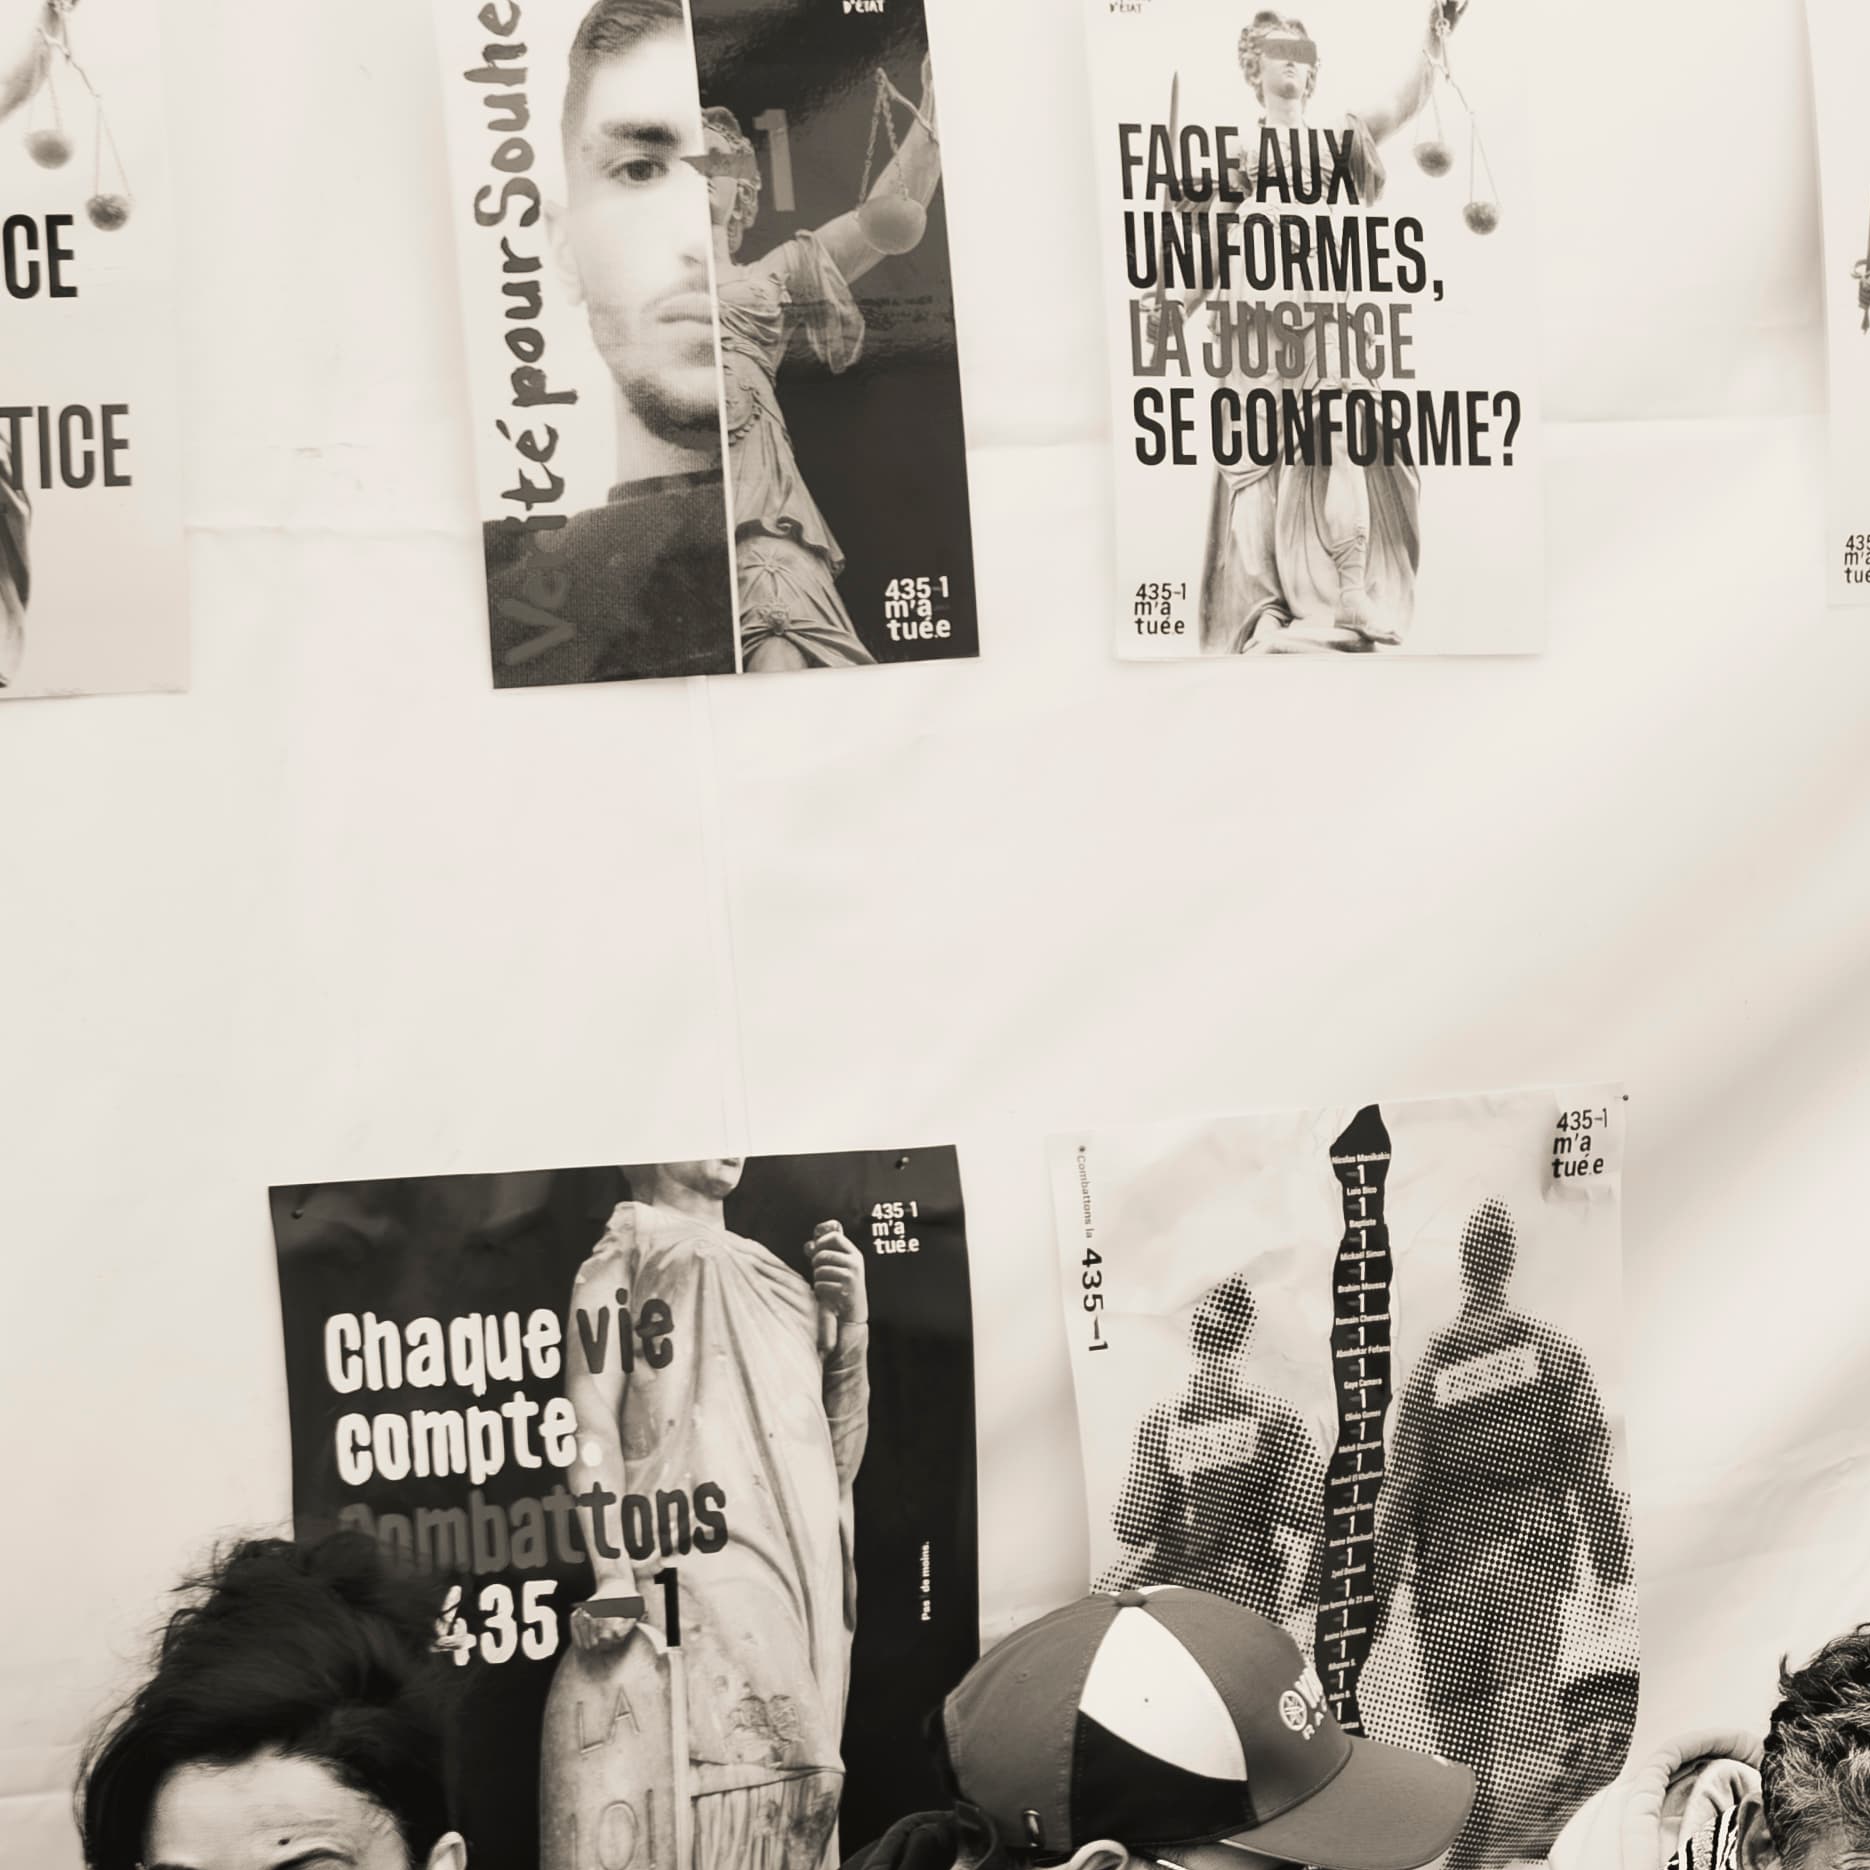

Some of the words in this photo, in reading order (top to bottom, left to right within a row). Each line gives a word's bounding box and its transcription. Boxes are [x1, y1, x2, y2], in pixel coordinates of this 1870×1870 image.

[1119, 124, 1241, 202] FACE
[1255, 127, 1358, 204] AUX
[1126, 212, 1444, 302] UNIFORMES,
[501, 236, 577, 405] pour
[1129, 300, 1192, 377] LA
[1203, 302, 1414, 380] JUSTICE
[1134, 388, 1198, 466] SE
[1211, 390, 1520, 466] CONFORME?
[884, 598, 933, 618] m'a
[1134, 601, 1171, 616] m'a
[1135, 582, 1187, 600] 435-1
[1552, 1133, 1592, 1155] m'a
[1555, 1107, 1608, 1132] 435-1
[871, 1219, 906, 1237] m'a
[1082, 1248, 1109, 1352] 435-1
[326, 1307, 562, 1397] Chaque
[576, 1287, 674, 1374] vie
[335, 1391, 602, 1485] compte.
[576, 1686, 644, 1754] LA
